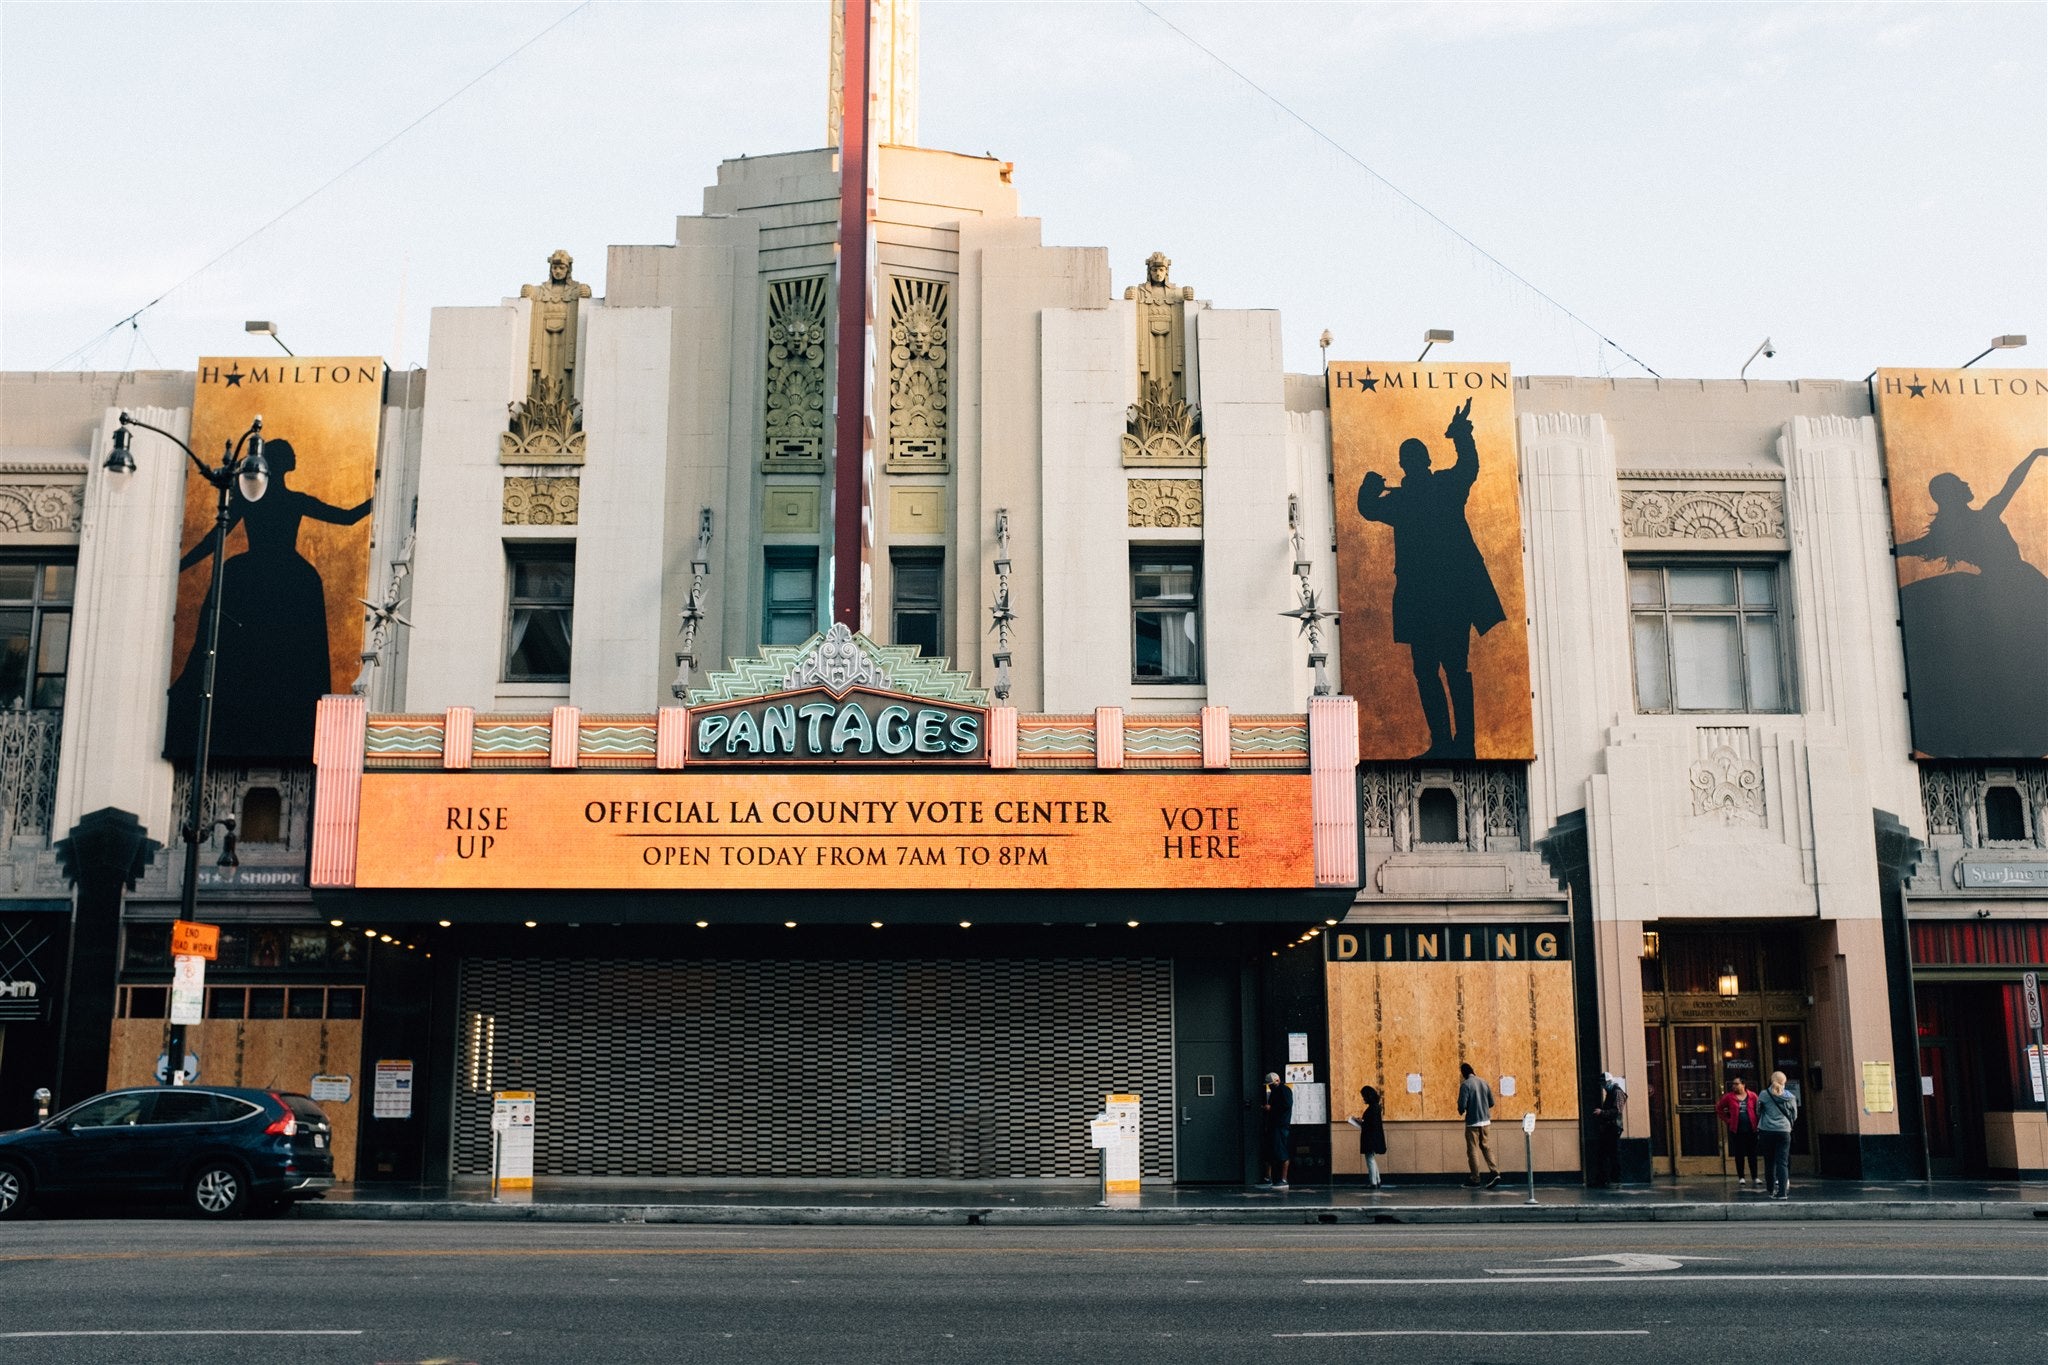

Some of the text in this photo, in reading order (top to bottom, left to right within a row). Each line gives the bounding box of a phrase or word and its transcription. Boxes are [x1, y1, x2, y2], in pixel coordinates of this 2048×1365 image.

[698, 703, 979, 754] PANTAGES
[446, 807, 508, 830] RISE
[585, 801, 1112, 823] OFFICIAL LA COUNTY VOTE CENTER
[1161, 807, 1239, 831] VOTE
[456, 835, 495, 859] UP
[643, 846, 1049, 866] OPEN TODAY FROM 7AM TO 8PM
[1163, 835, 1240, 859] HERE
[240, 872, 300, 884] SHOPPE
[185, 927, 200, 939] END
[192, 943, 213, 953] WORK
[1336, 932, 1558, 959] DINING
